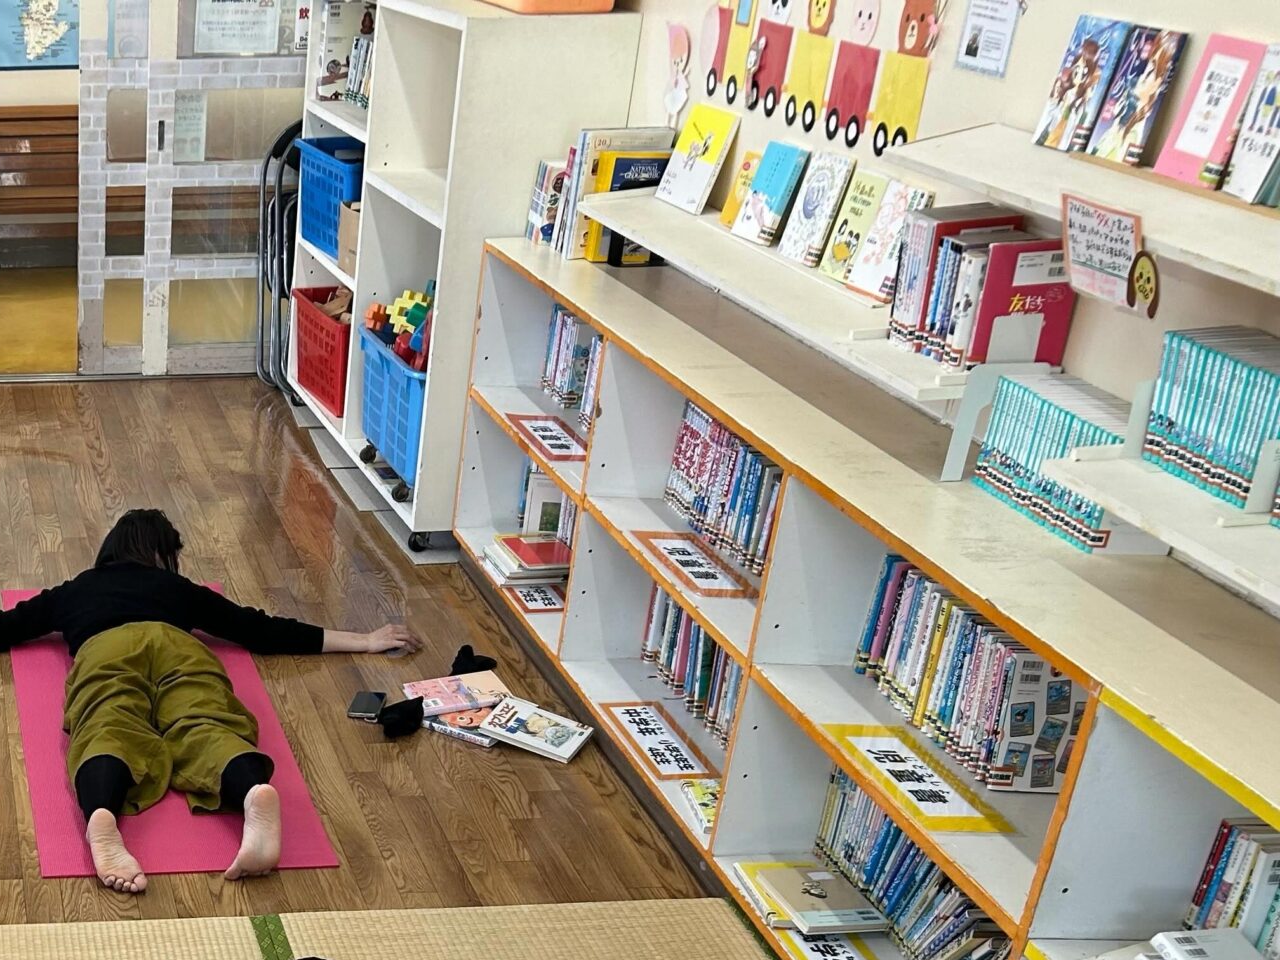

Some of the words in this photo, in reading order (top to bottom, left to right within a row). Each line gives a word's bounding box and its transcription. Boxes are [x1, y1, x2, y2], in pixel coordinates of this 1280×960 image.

[1008, 293, 1046, 313] 友だち
[662, 546, 719, 580] 児童書
[621, 708, 659, 736] 中学年
[647, 746, 672, 765] 4年生
[865, 748, 950, 804] 児童書
